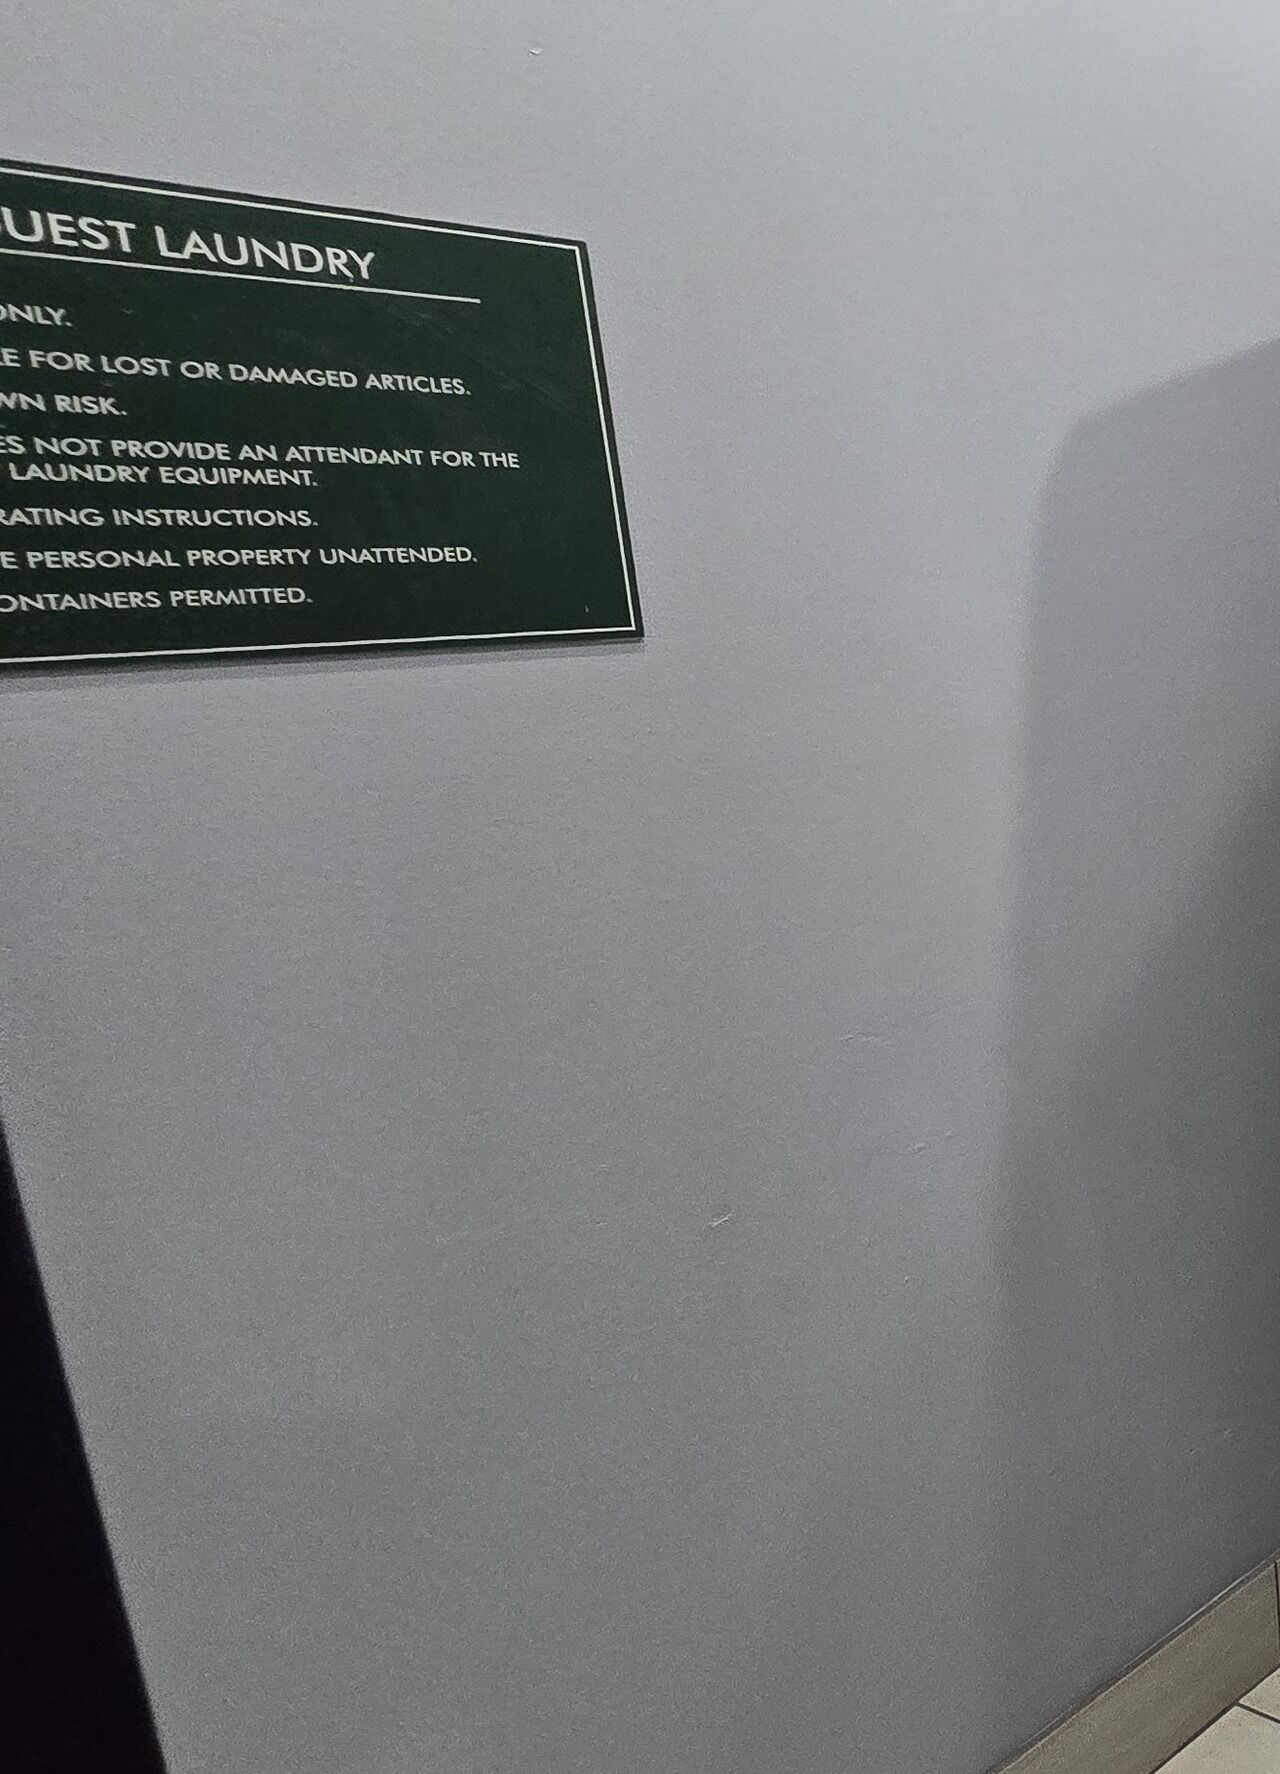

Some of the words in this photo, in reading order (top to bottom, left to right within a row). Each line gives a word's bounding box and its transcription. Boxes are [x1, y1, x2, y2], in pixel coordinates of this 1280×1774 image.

[0, 205, 136, 253] UEST
[155, 226, 376, 280] LAUNDRY
[29, 350, 94, 372] FOR
[101, 355, 171, 376] LOST
[180, 361, 222, 380] OR
[228, 364, 357, 387] DAMAGED
[365, 374, 470, 395] ARTICLES.
[54, 395, 127, 415] RISK.
[34, 437, 102, 456] NOT
[111, 440, 231, 460] PROVIDE
[239, 445, 278, 461] AN
[285, 446, 423, 465] ATTENDANT
[430, 451, 476, 467] FOR
[479, 452, 520, 468] THE
[9, 463, 149, 482] LAUNDRY
[159, 467, 317, 486] EQUIPMENT.
[112, 509, 318, 526] INSTRUCTIONS.
[26, 550, 180, 568] PERSONAL
[187, 549, 311, 566] PROPERTY
[320, 547, 477, 564] UNATTENDED.
[0, 591, 161, 612] ONTAINERS
[170, 588, 312, 607] PERMITTED.
